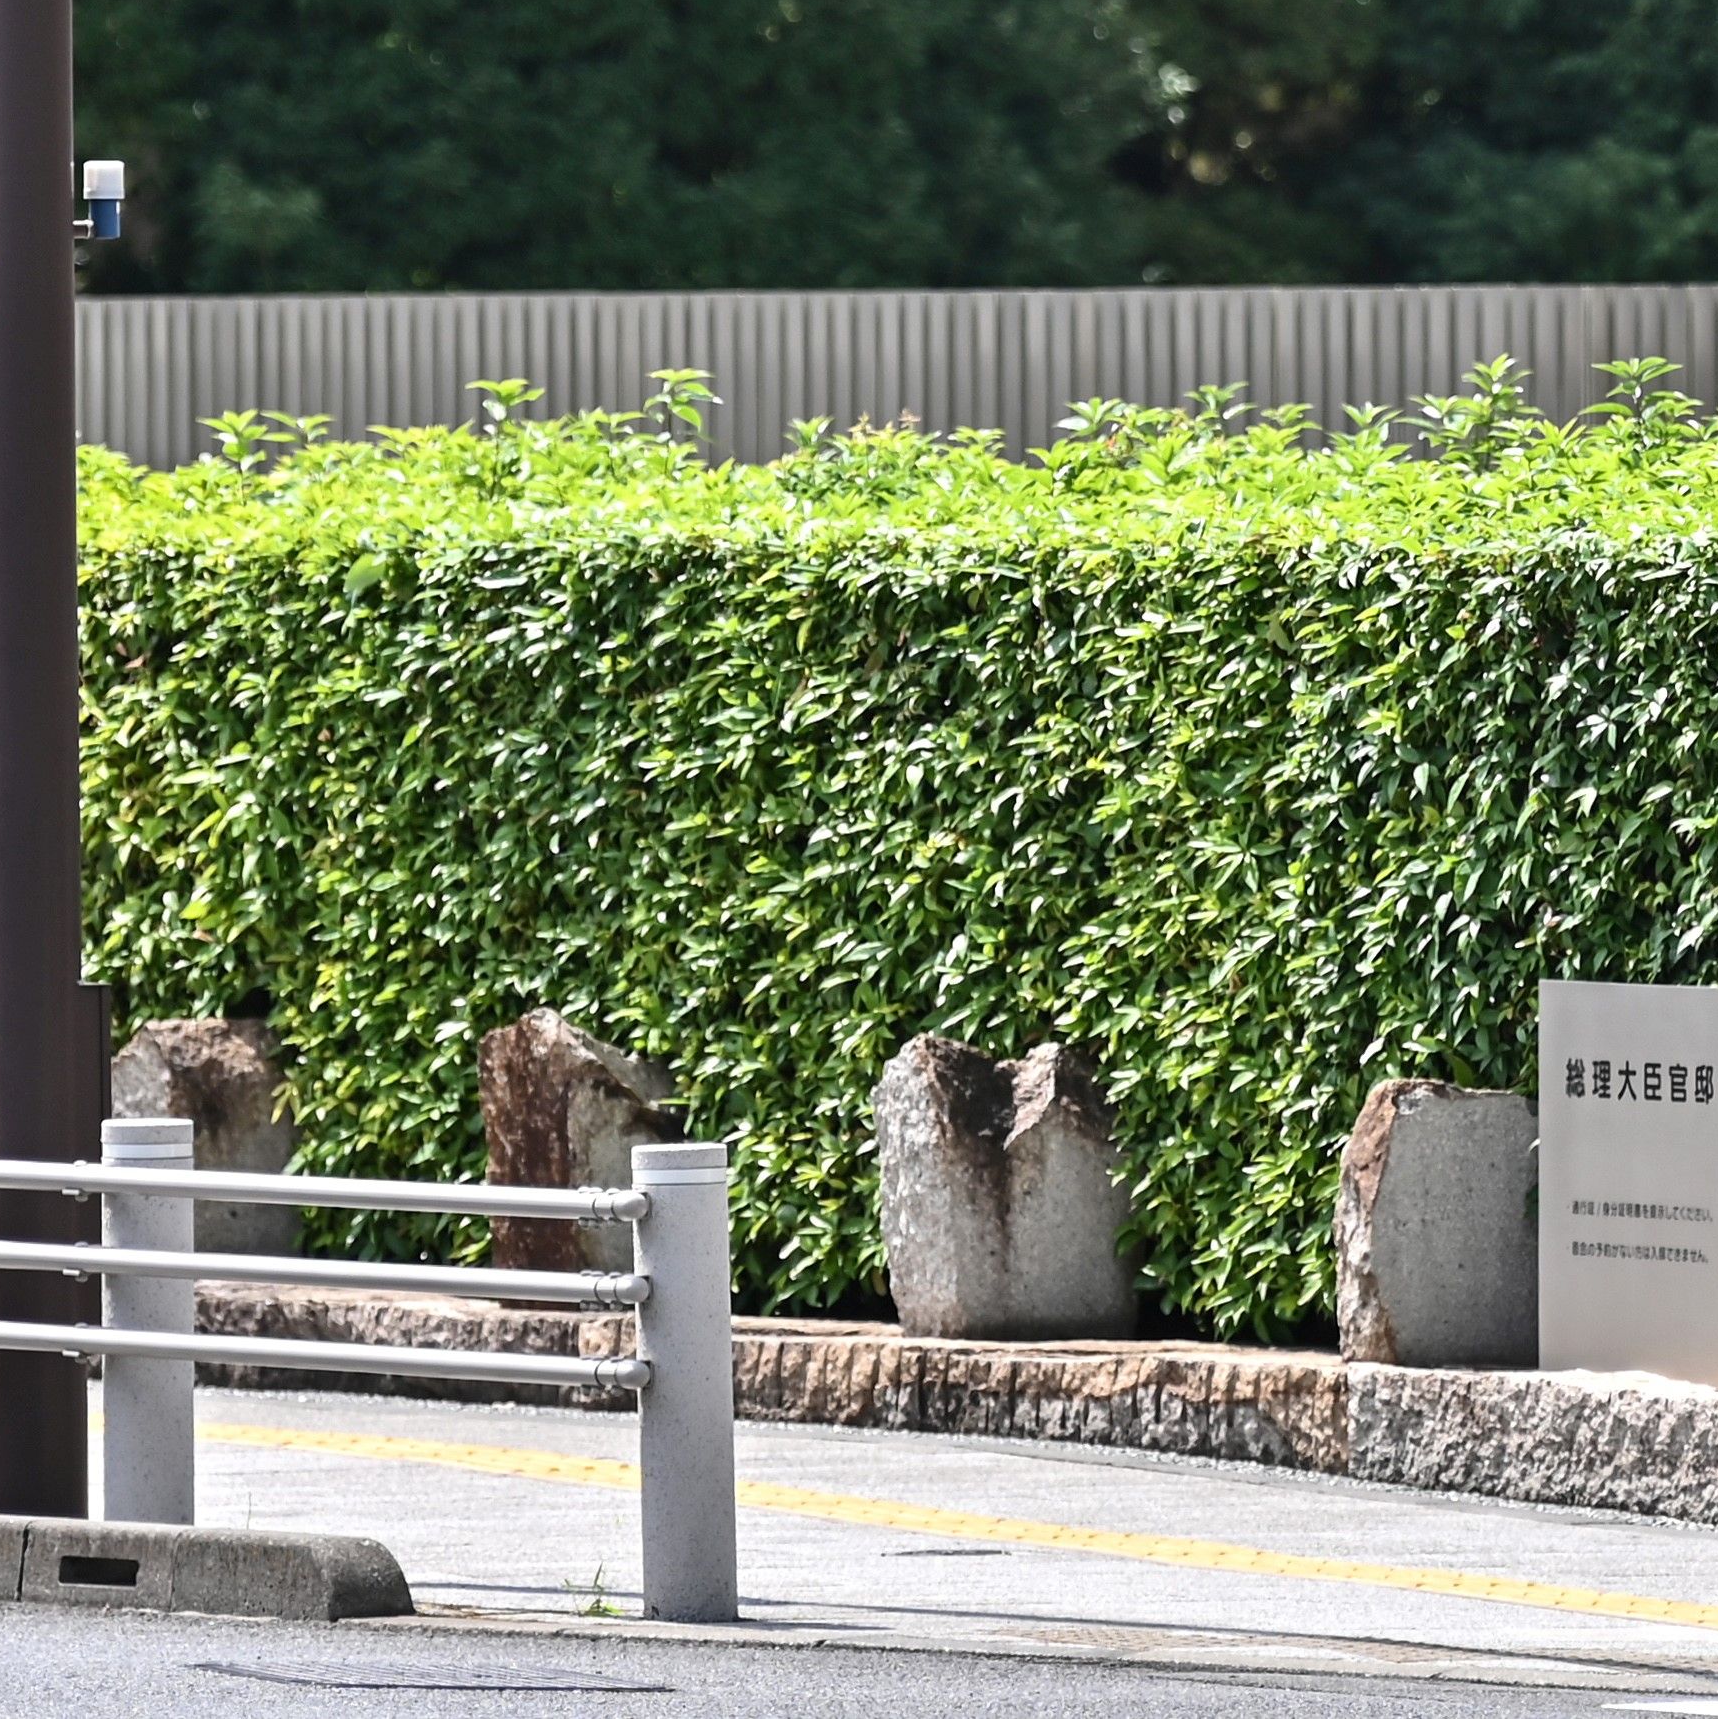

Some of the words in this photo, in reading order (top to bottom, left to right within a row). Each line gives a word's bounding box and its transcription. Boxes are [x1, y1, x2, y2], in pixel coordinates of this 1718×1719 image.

[1566, 1058, 1714, 1105] 総理大臣官邸
